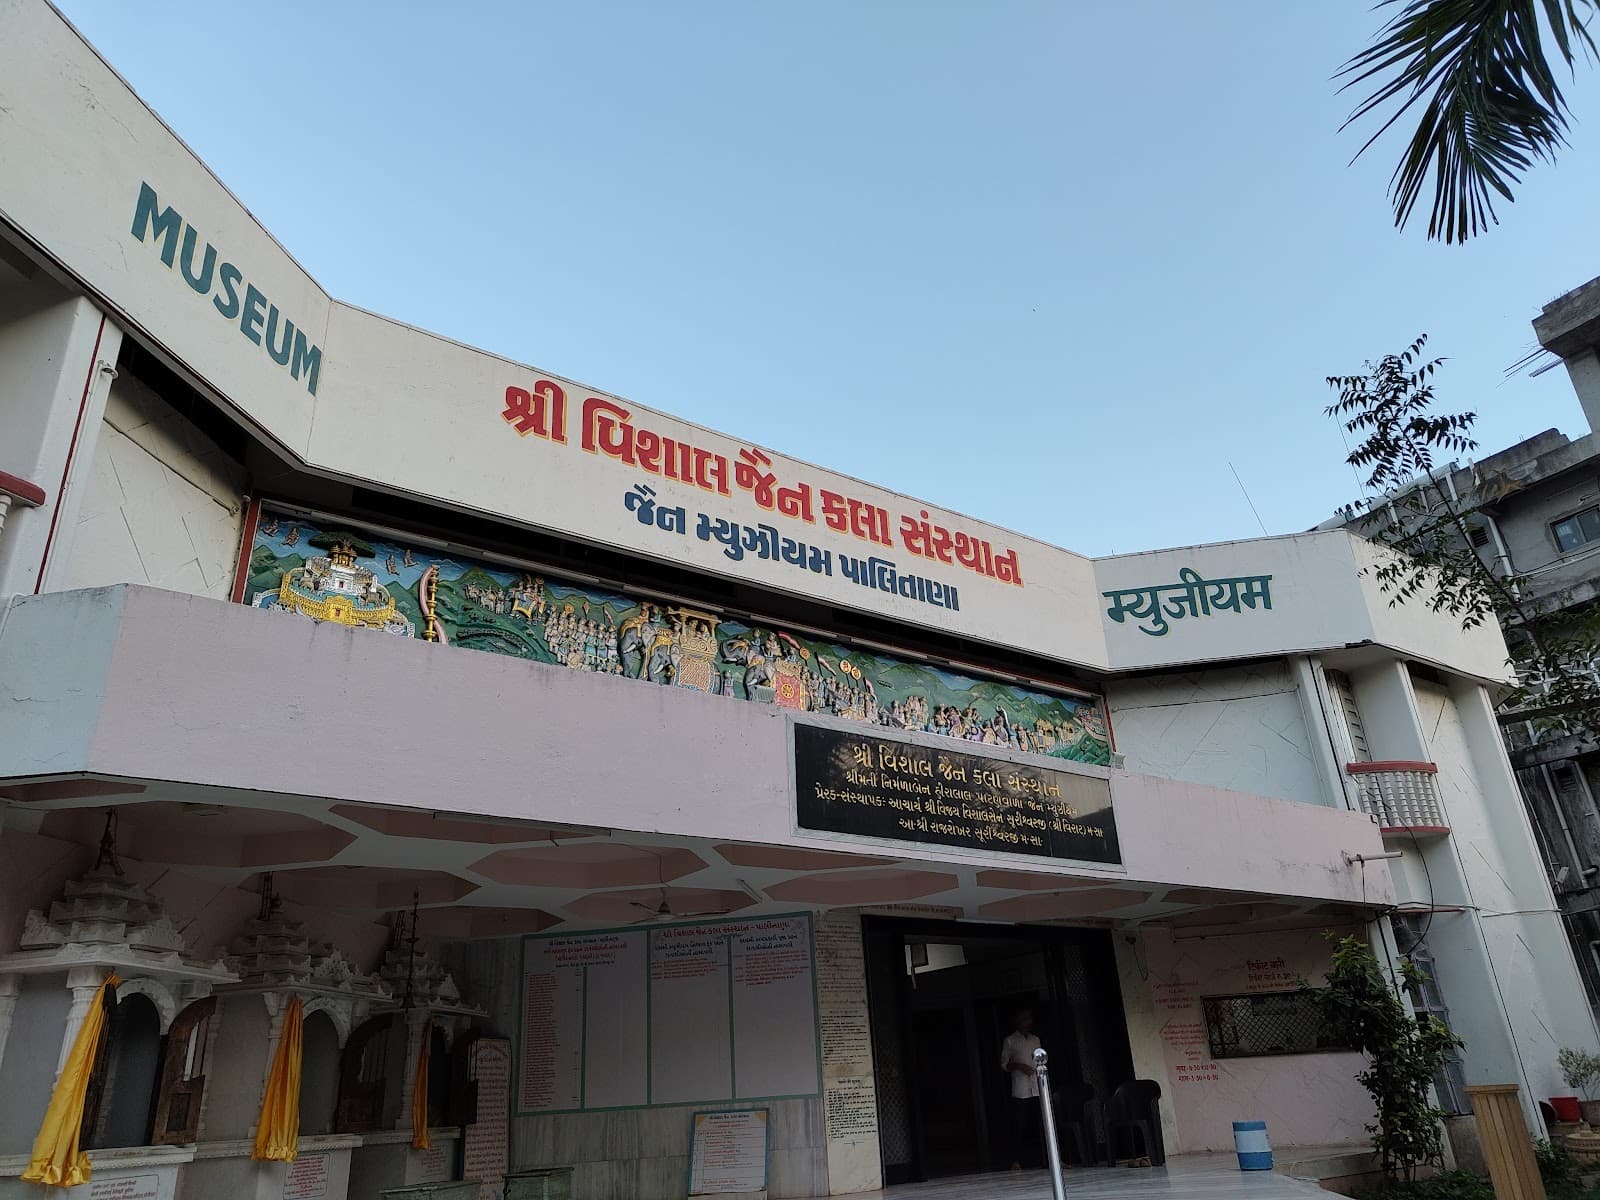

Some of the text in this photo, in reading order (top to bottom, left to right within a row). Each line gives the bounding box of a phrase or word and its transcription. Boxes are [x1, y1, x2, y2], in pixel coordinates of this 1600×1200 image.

[131, 180, 322, 397] MUSEUM
[502, 379, 568, 445] શ્રી
[734, 447, 817, 525] જૈન
[819, 488, 895, 547] કલા
[899, 510, 1025, 588] સંસ્થાન
[624, 484, 961, 612] જૈન મ્યુઝીયમ પાલિતાણા
[1102, 567, 1273, 637] म्युजीयम
[845, 767, 877, 788] શ્રીમતી
[853, 744, 1061, 797] શ્રી વિશાલ જૈન કલા સંસ્થાન
